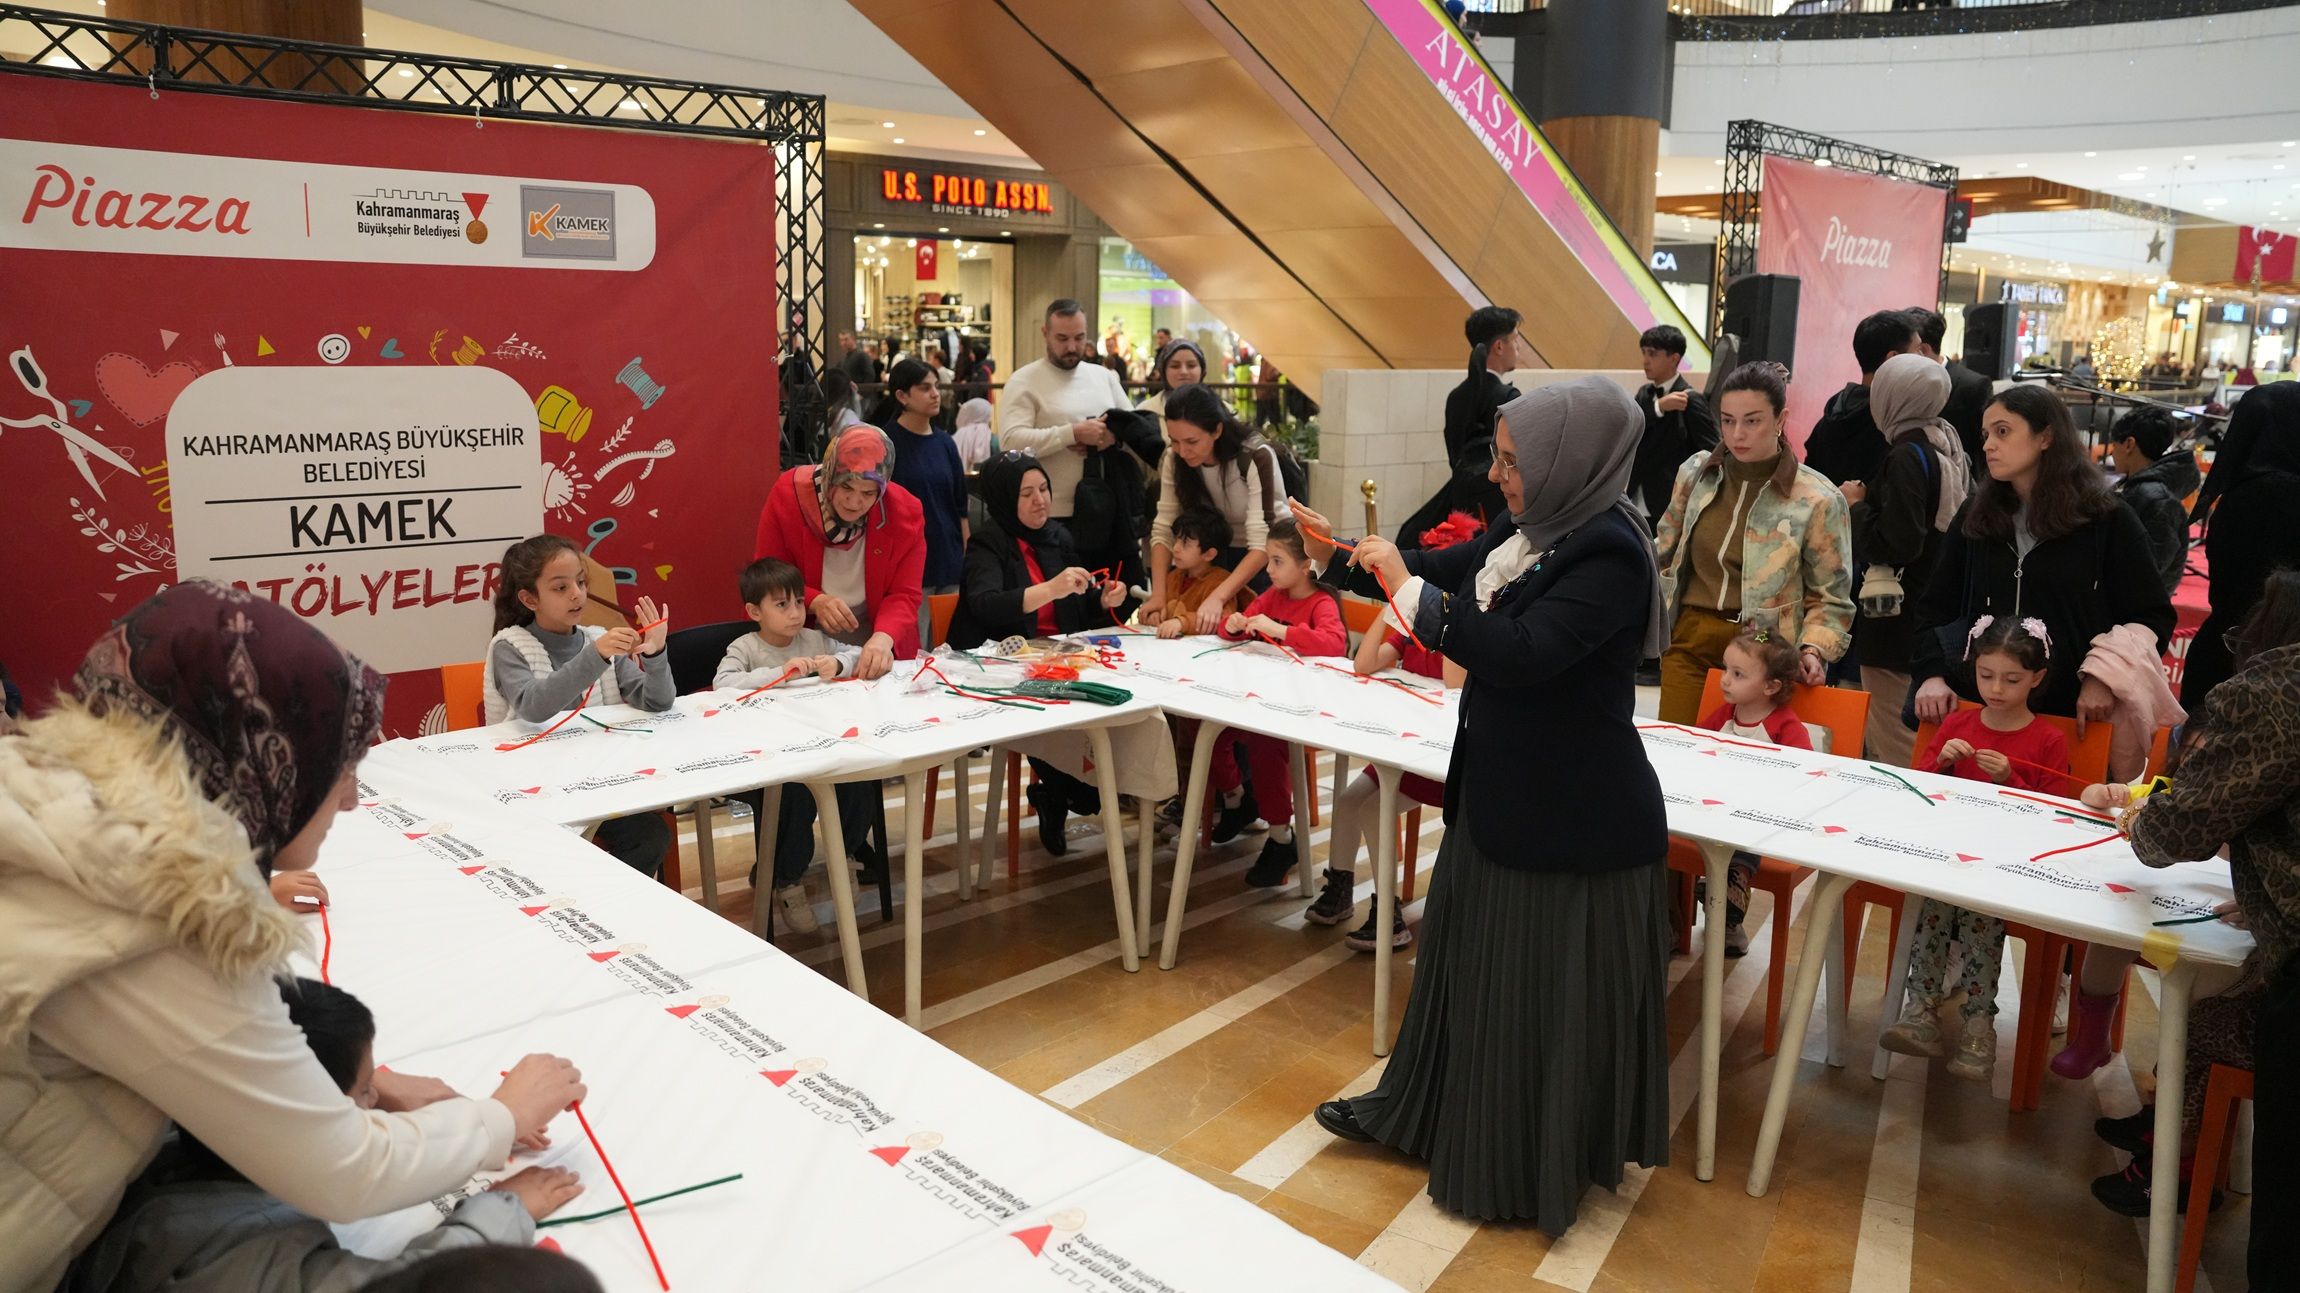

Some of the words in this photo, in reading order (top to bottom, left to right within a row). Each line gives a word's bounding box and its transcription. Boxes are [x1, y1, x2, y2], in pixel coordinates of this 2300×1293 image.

[1425, 28, 1542, 168] ATASAY
[22, 164, 251, 234] Piazza
[883, 170, 922, 201] U.S.
[933, 174, 987, 206] POLO
[995, 180, 1054, 212] ASSN.
[932, 204, 972, 216] SINCE
[977, 206, 1010, 218] 1890
[356, 201, 460, 224] Kahramanmaraş
[357, 221, 411, 238] Büyükşehir
[413, 224, 461, 239] Belediyesi
[556, 217, 608, 232] KAMEK
[1820, 215, 1893, 269] Piazza
[183, 431, 391, 456] KAHRAMANMARAŞ
[398, 426, 525, 452] BÜYÜKŞEHİR
[304, 455, 425, 483] BELEDİYESİ
[290, 497, 457, 548] KAMEK
[232, 562, 501, 617] TÖLYELER
[914, 1155, 1016, 1220] Kahramanmaraş
